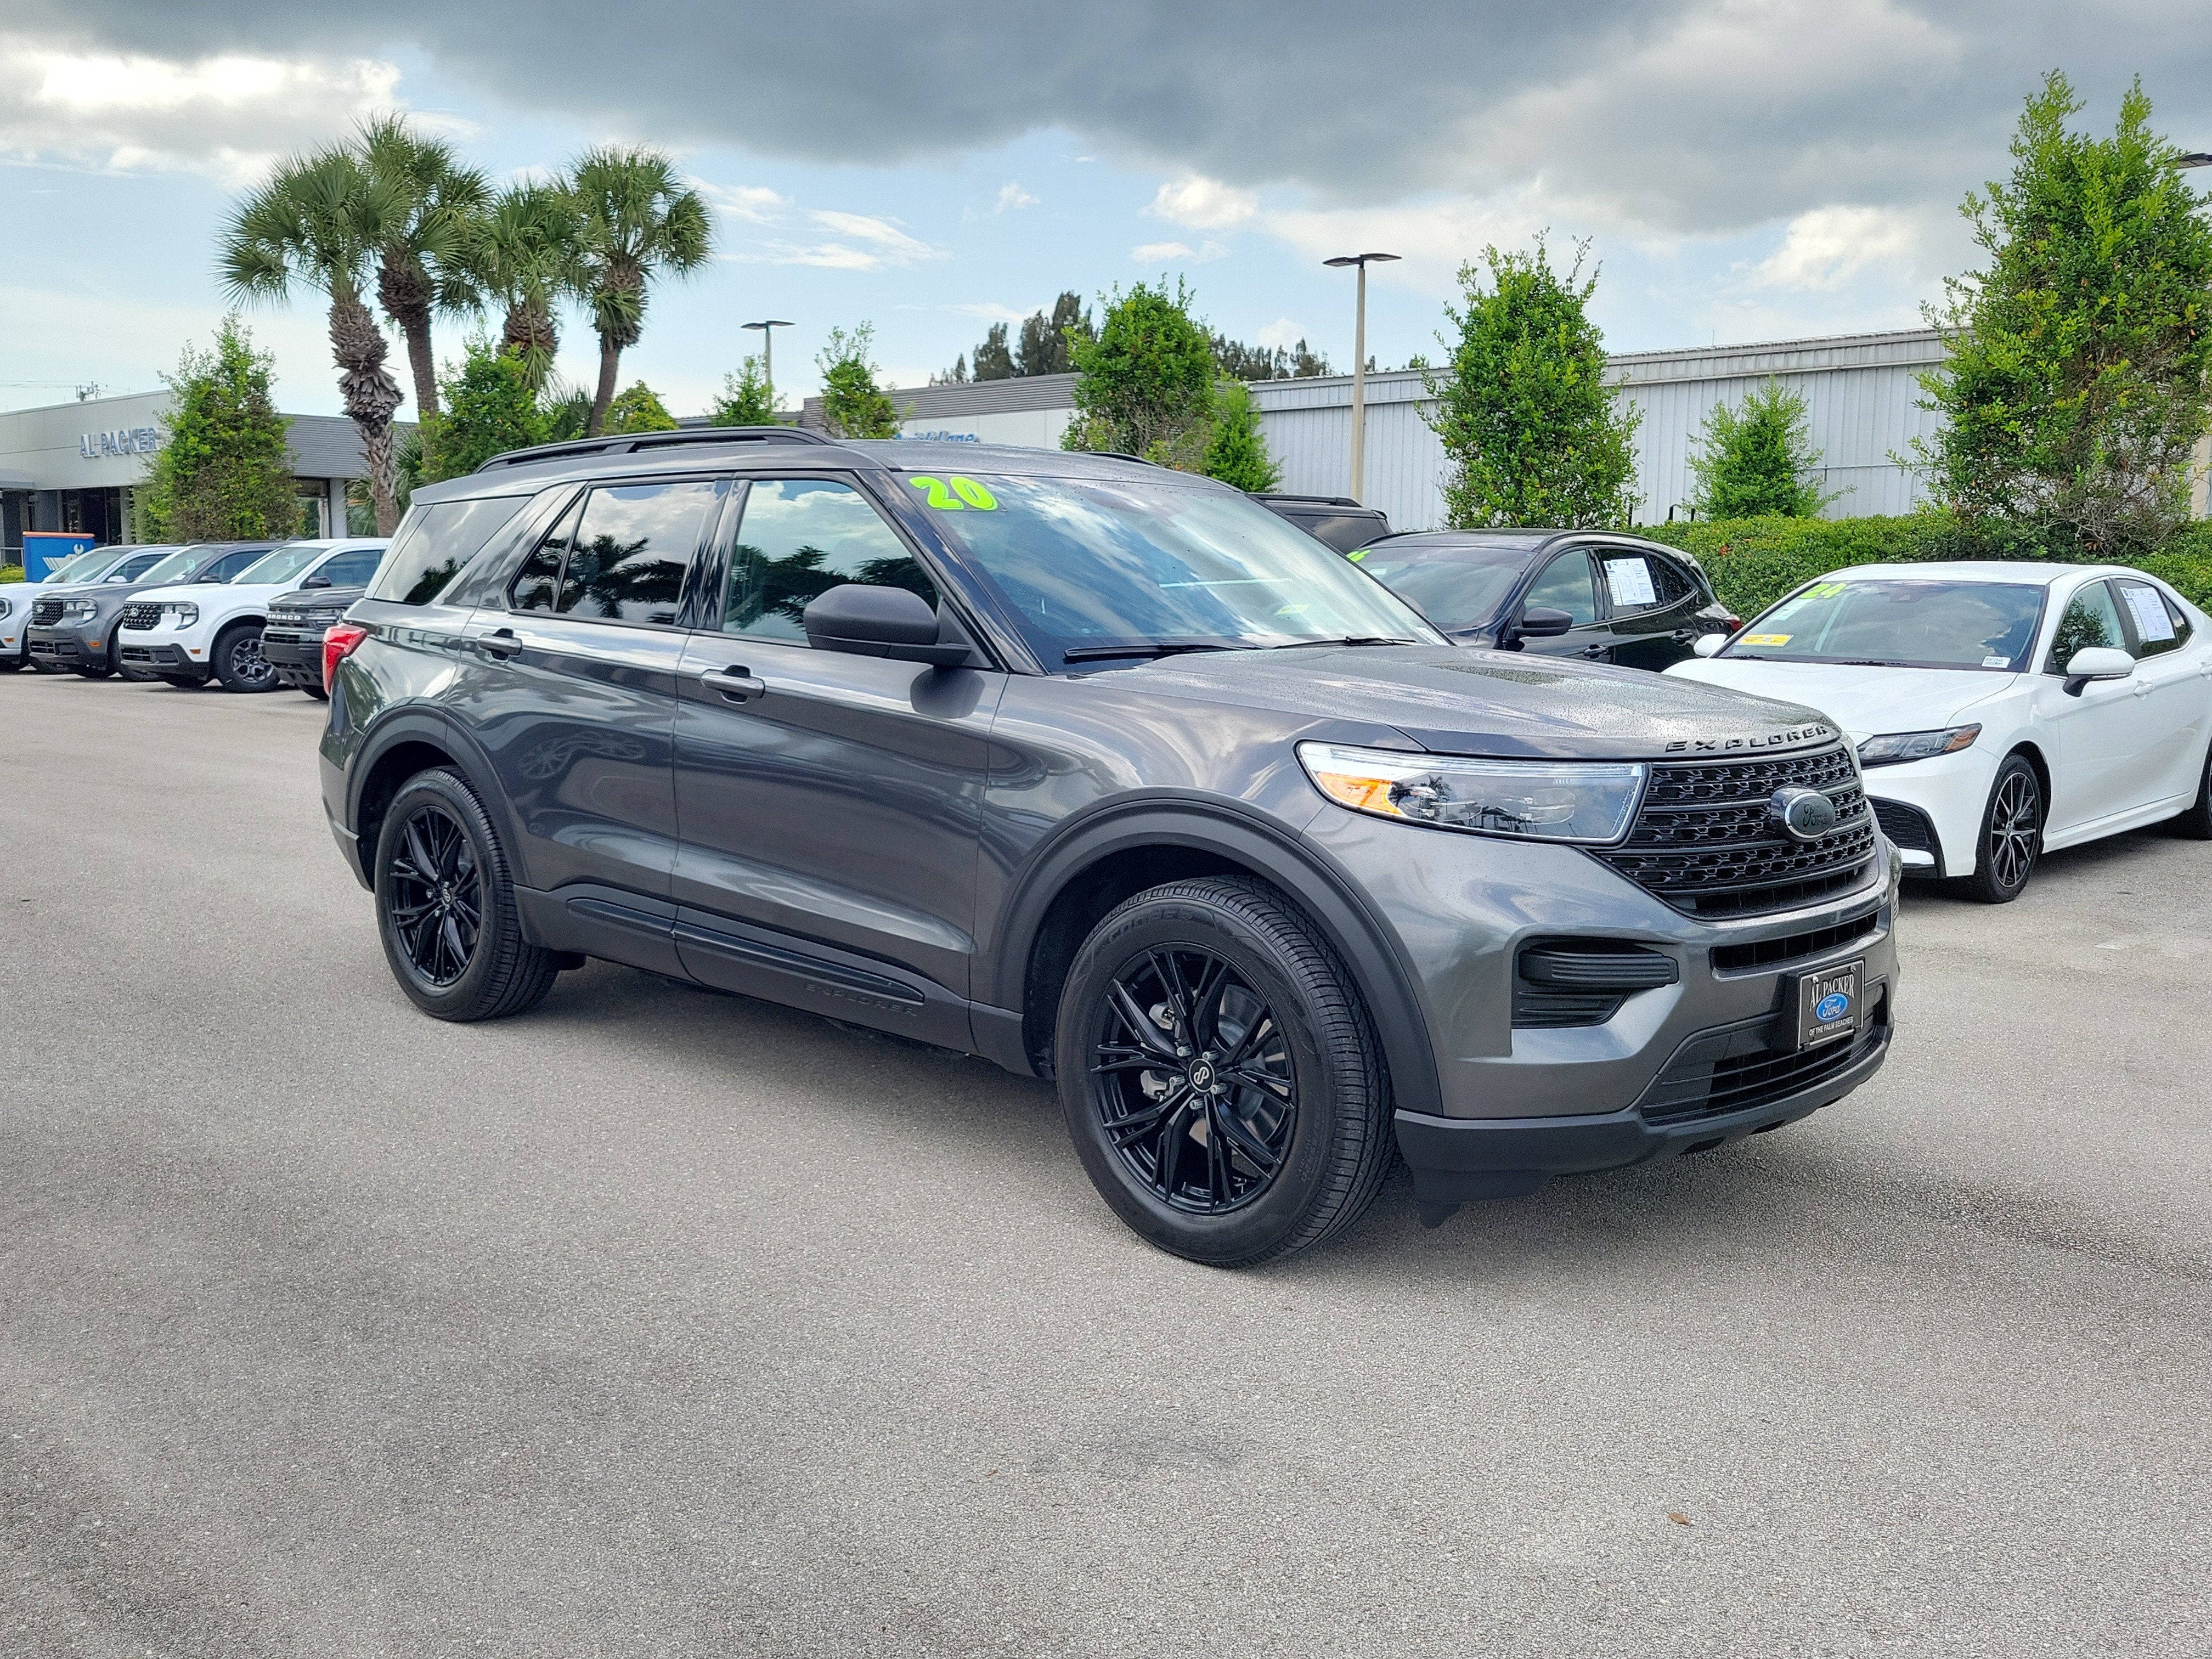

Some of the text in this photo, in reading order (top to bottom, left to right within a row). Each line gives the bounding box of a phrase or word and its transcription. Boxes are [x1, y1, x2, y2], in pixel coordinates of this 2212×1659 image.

[80, 427, 156, 457] AL PACKER
[909, 476, 998, 510] 20
[1798, 583, 1847, 599] 24
[1665, 725, 1830, 753] EXPLORER
[1809, 974, 1855, 1012] AL PACKER
[1822, 998, 1842, 1018] Ford
[1809, 1016, 1853, 1036] OF THE PALM BEACHES
